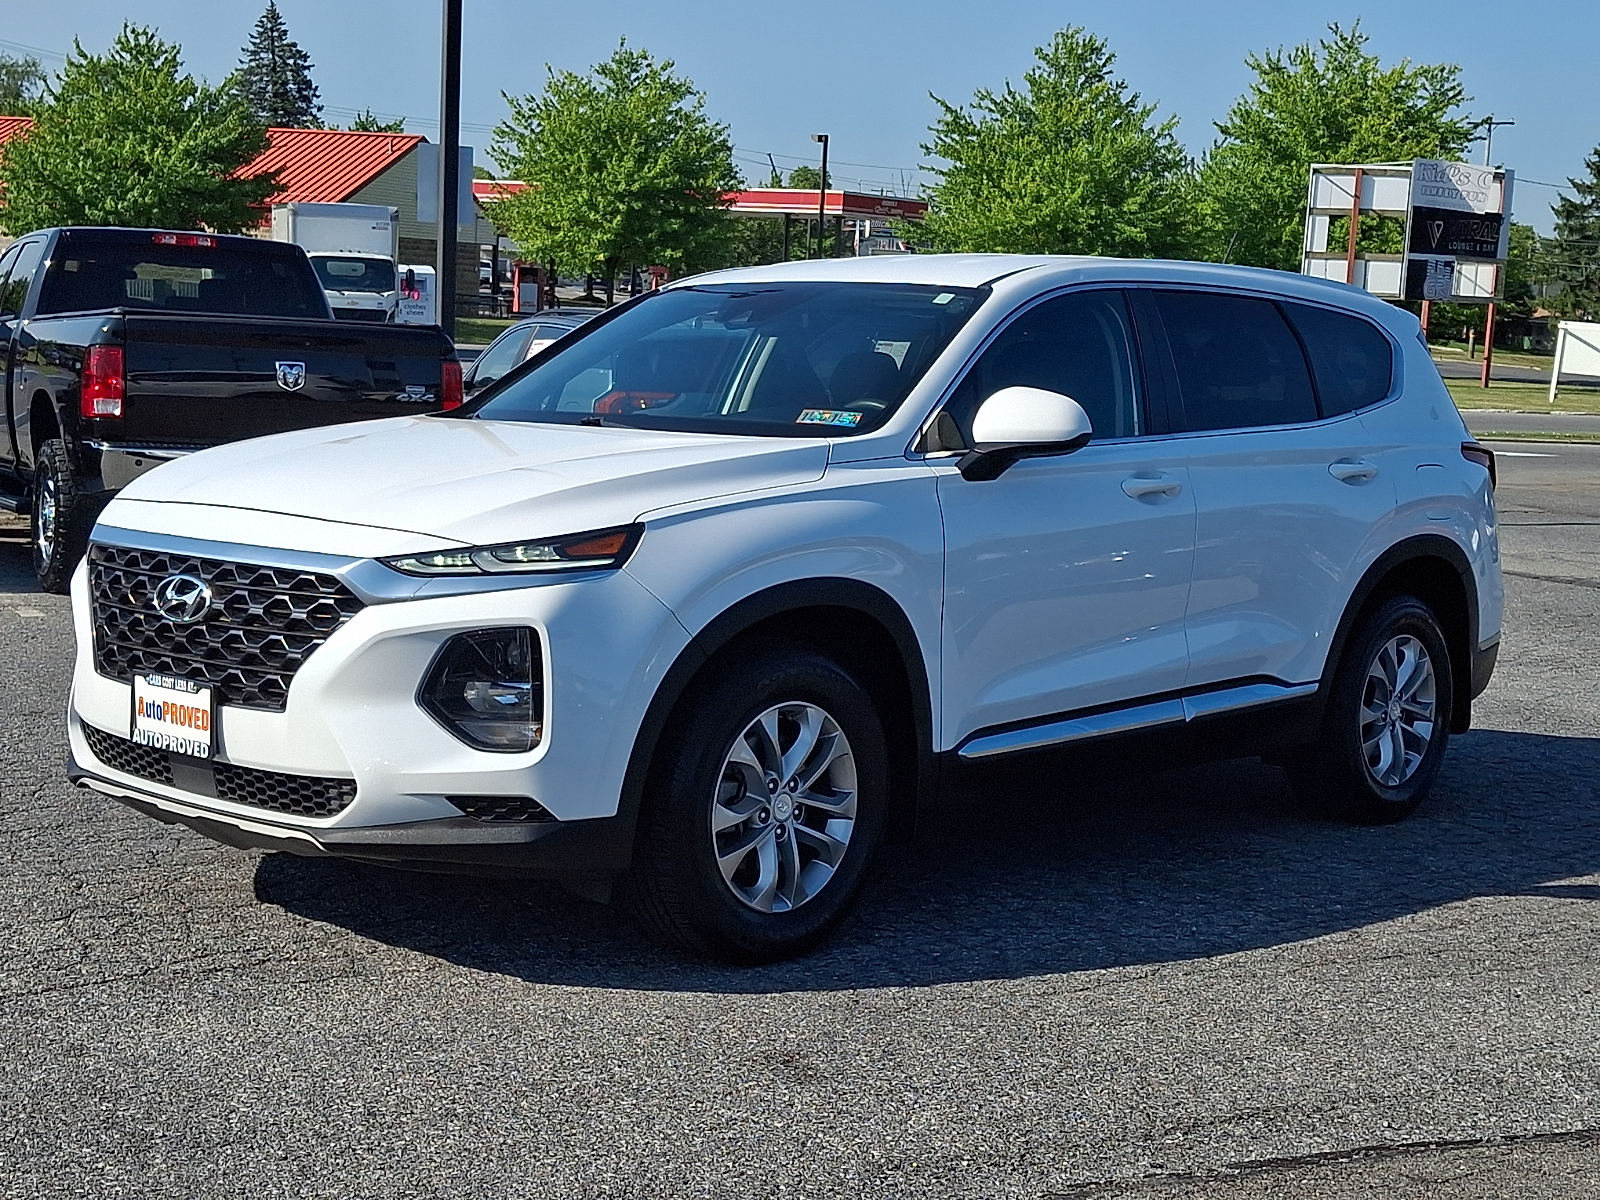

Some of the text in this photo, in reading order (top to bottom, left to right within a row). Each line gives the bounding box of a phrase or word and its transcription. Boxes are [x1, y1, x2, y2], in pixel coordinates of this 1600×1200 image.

[162, 676, 175, 689] COST
[138, 696, 209, 731] AutoPROVED
[132, 728, 209, 758] AUTOPROVED
